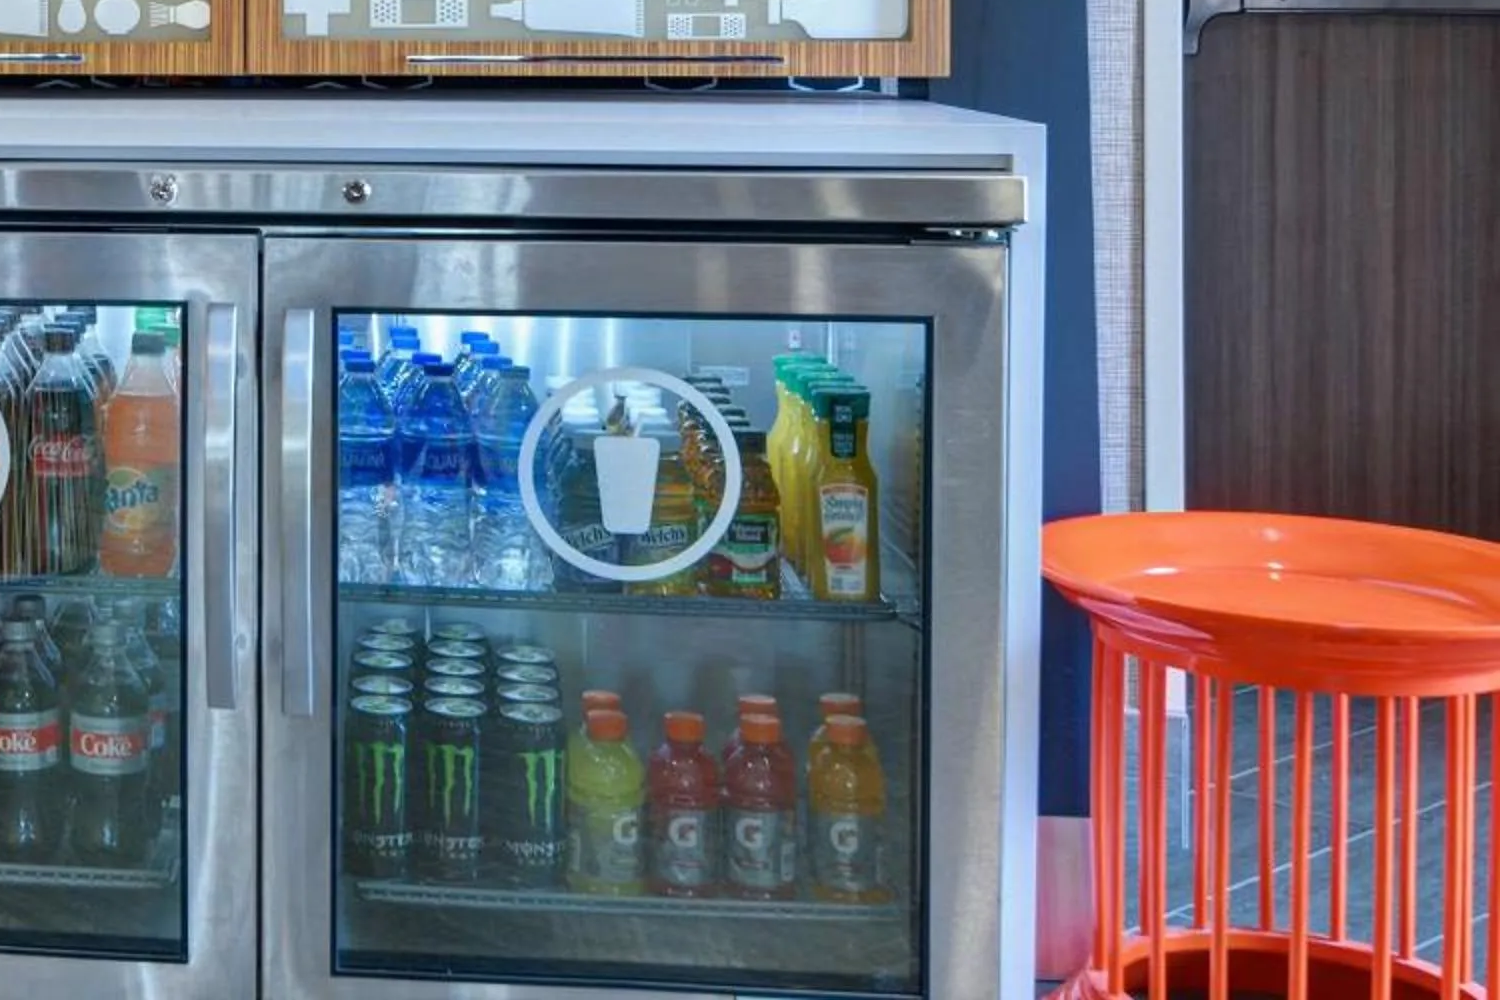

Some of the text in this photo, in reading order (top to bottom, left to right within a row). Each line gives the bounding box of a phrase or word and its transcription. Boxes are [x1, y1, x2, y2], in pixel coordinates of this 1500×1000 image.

[80, 733, 132, 757] Coke
[613, 815, 638, 845] G
[668, 816, 698, 848] G
[735, 818, 764, 849] G
[830, 821, 858, 853] G
